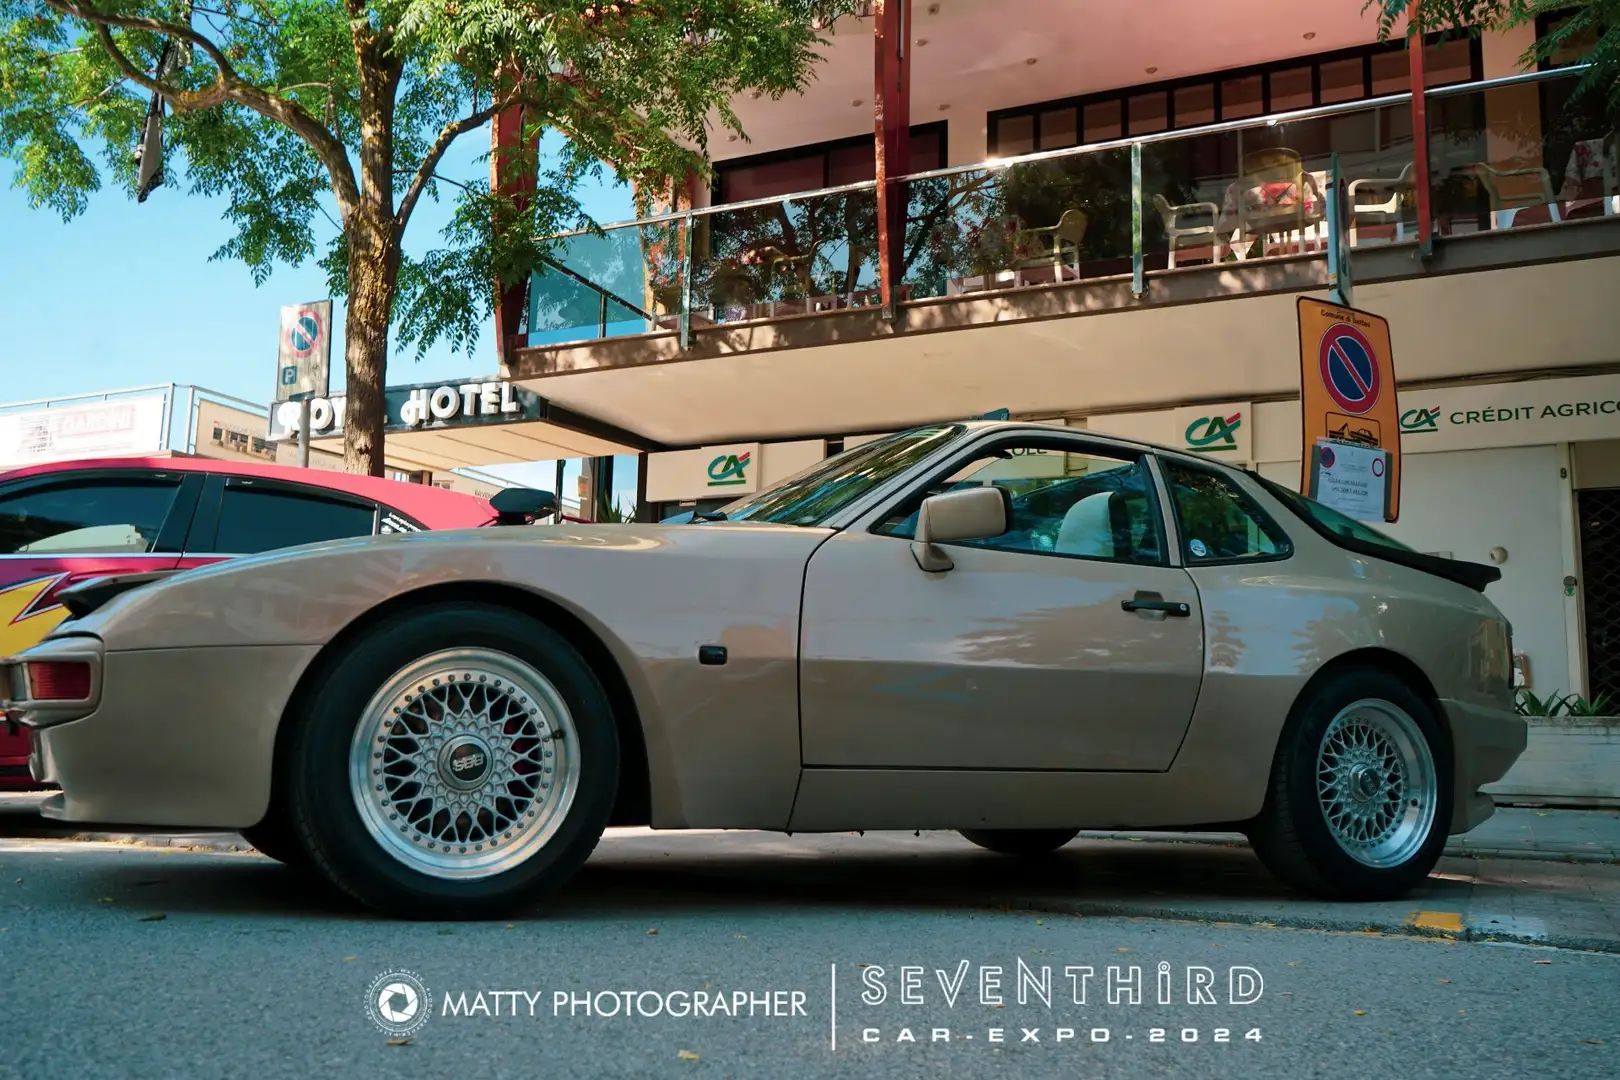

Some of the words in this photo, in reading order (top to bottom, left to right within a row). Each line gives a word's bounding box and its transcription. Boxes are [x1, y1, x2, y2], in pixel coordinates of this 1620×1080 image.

[400, 381, 520, 425] HOTEL
[1400, 406, 1440, 430] CA
[1450, 406, 1534, 425] CRÉDIT
[1540, 400, 1620, 418] AGRIC
[1185, 412, 1241, 446] CA
[708, 452, 750, 482] CA
[1560, 467, 1567, 479] 9
